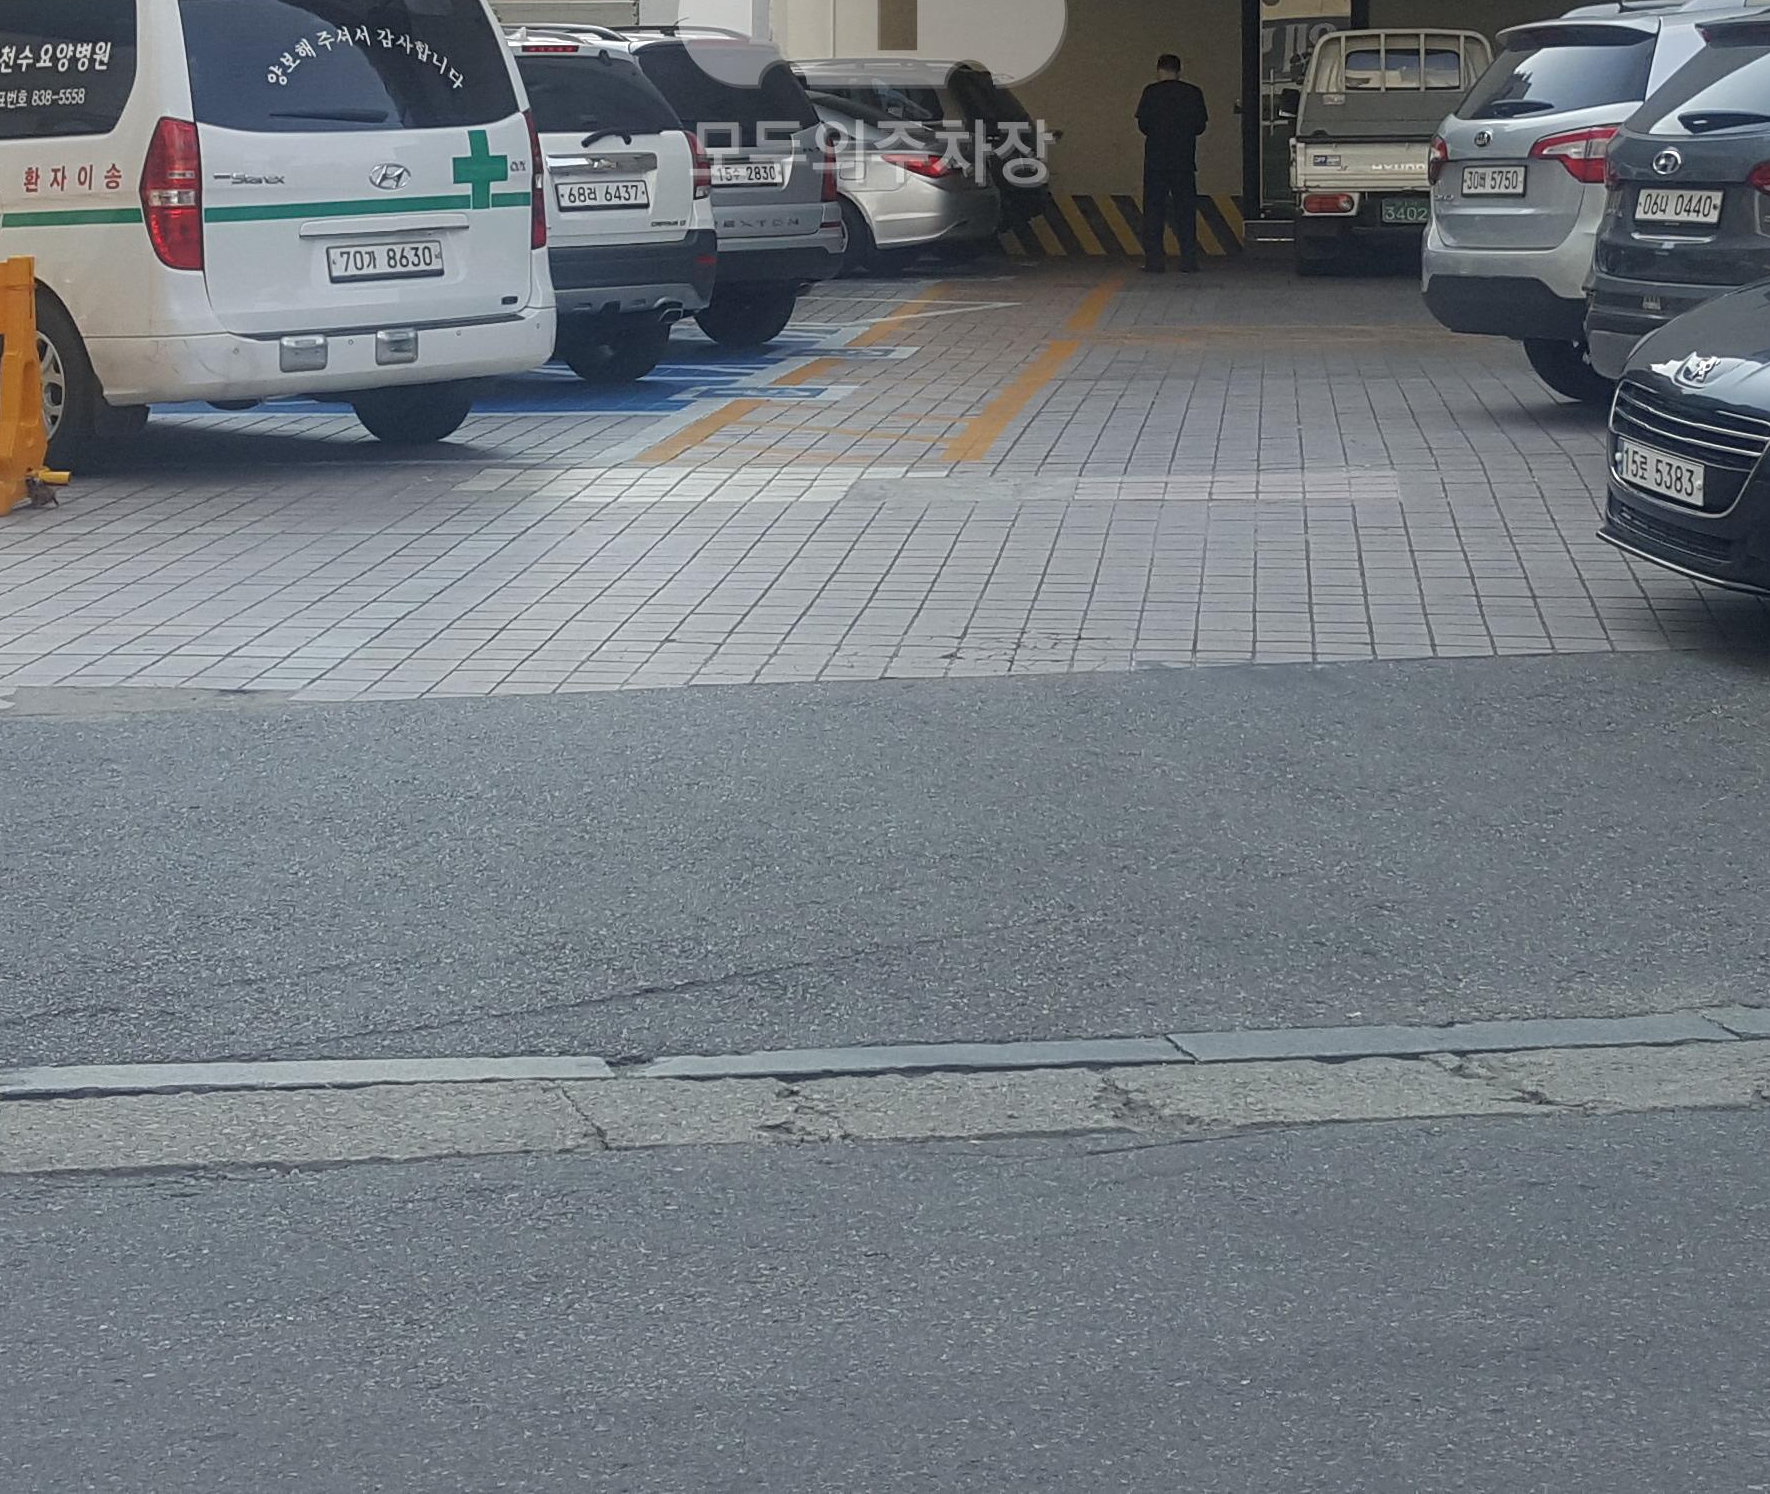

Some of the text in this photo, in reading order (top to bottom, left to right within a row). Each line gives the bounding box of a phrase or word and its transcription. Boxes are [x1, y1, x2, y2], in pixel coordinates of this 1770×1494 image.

[267, 25, 464, 89] 양보해 주셔서 감사합니다
[31, 87, 86, 107] 838-5558
[23, 162, 123, 193] 환자이송
[745, 165, 777, 182] 2830
[1489, 170, 1519, 190] 5750
[604, 184, 639, 202] 6437
[1384, 207, 1429, 222] 3402
[1642, 193, 1713, 217] 06너 0440
[339, 245, 434, 273] 70가 8630
[1624, 447, 1695, 497] 15로 5383
